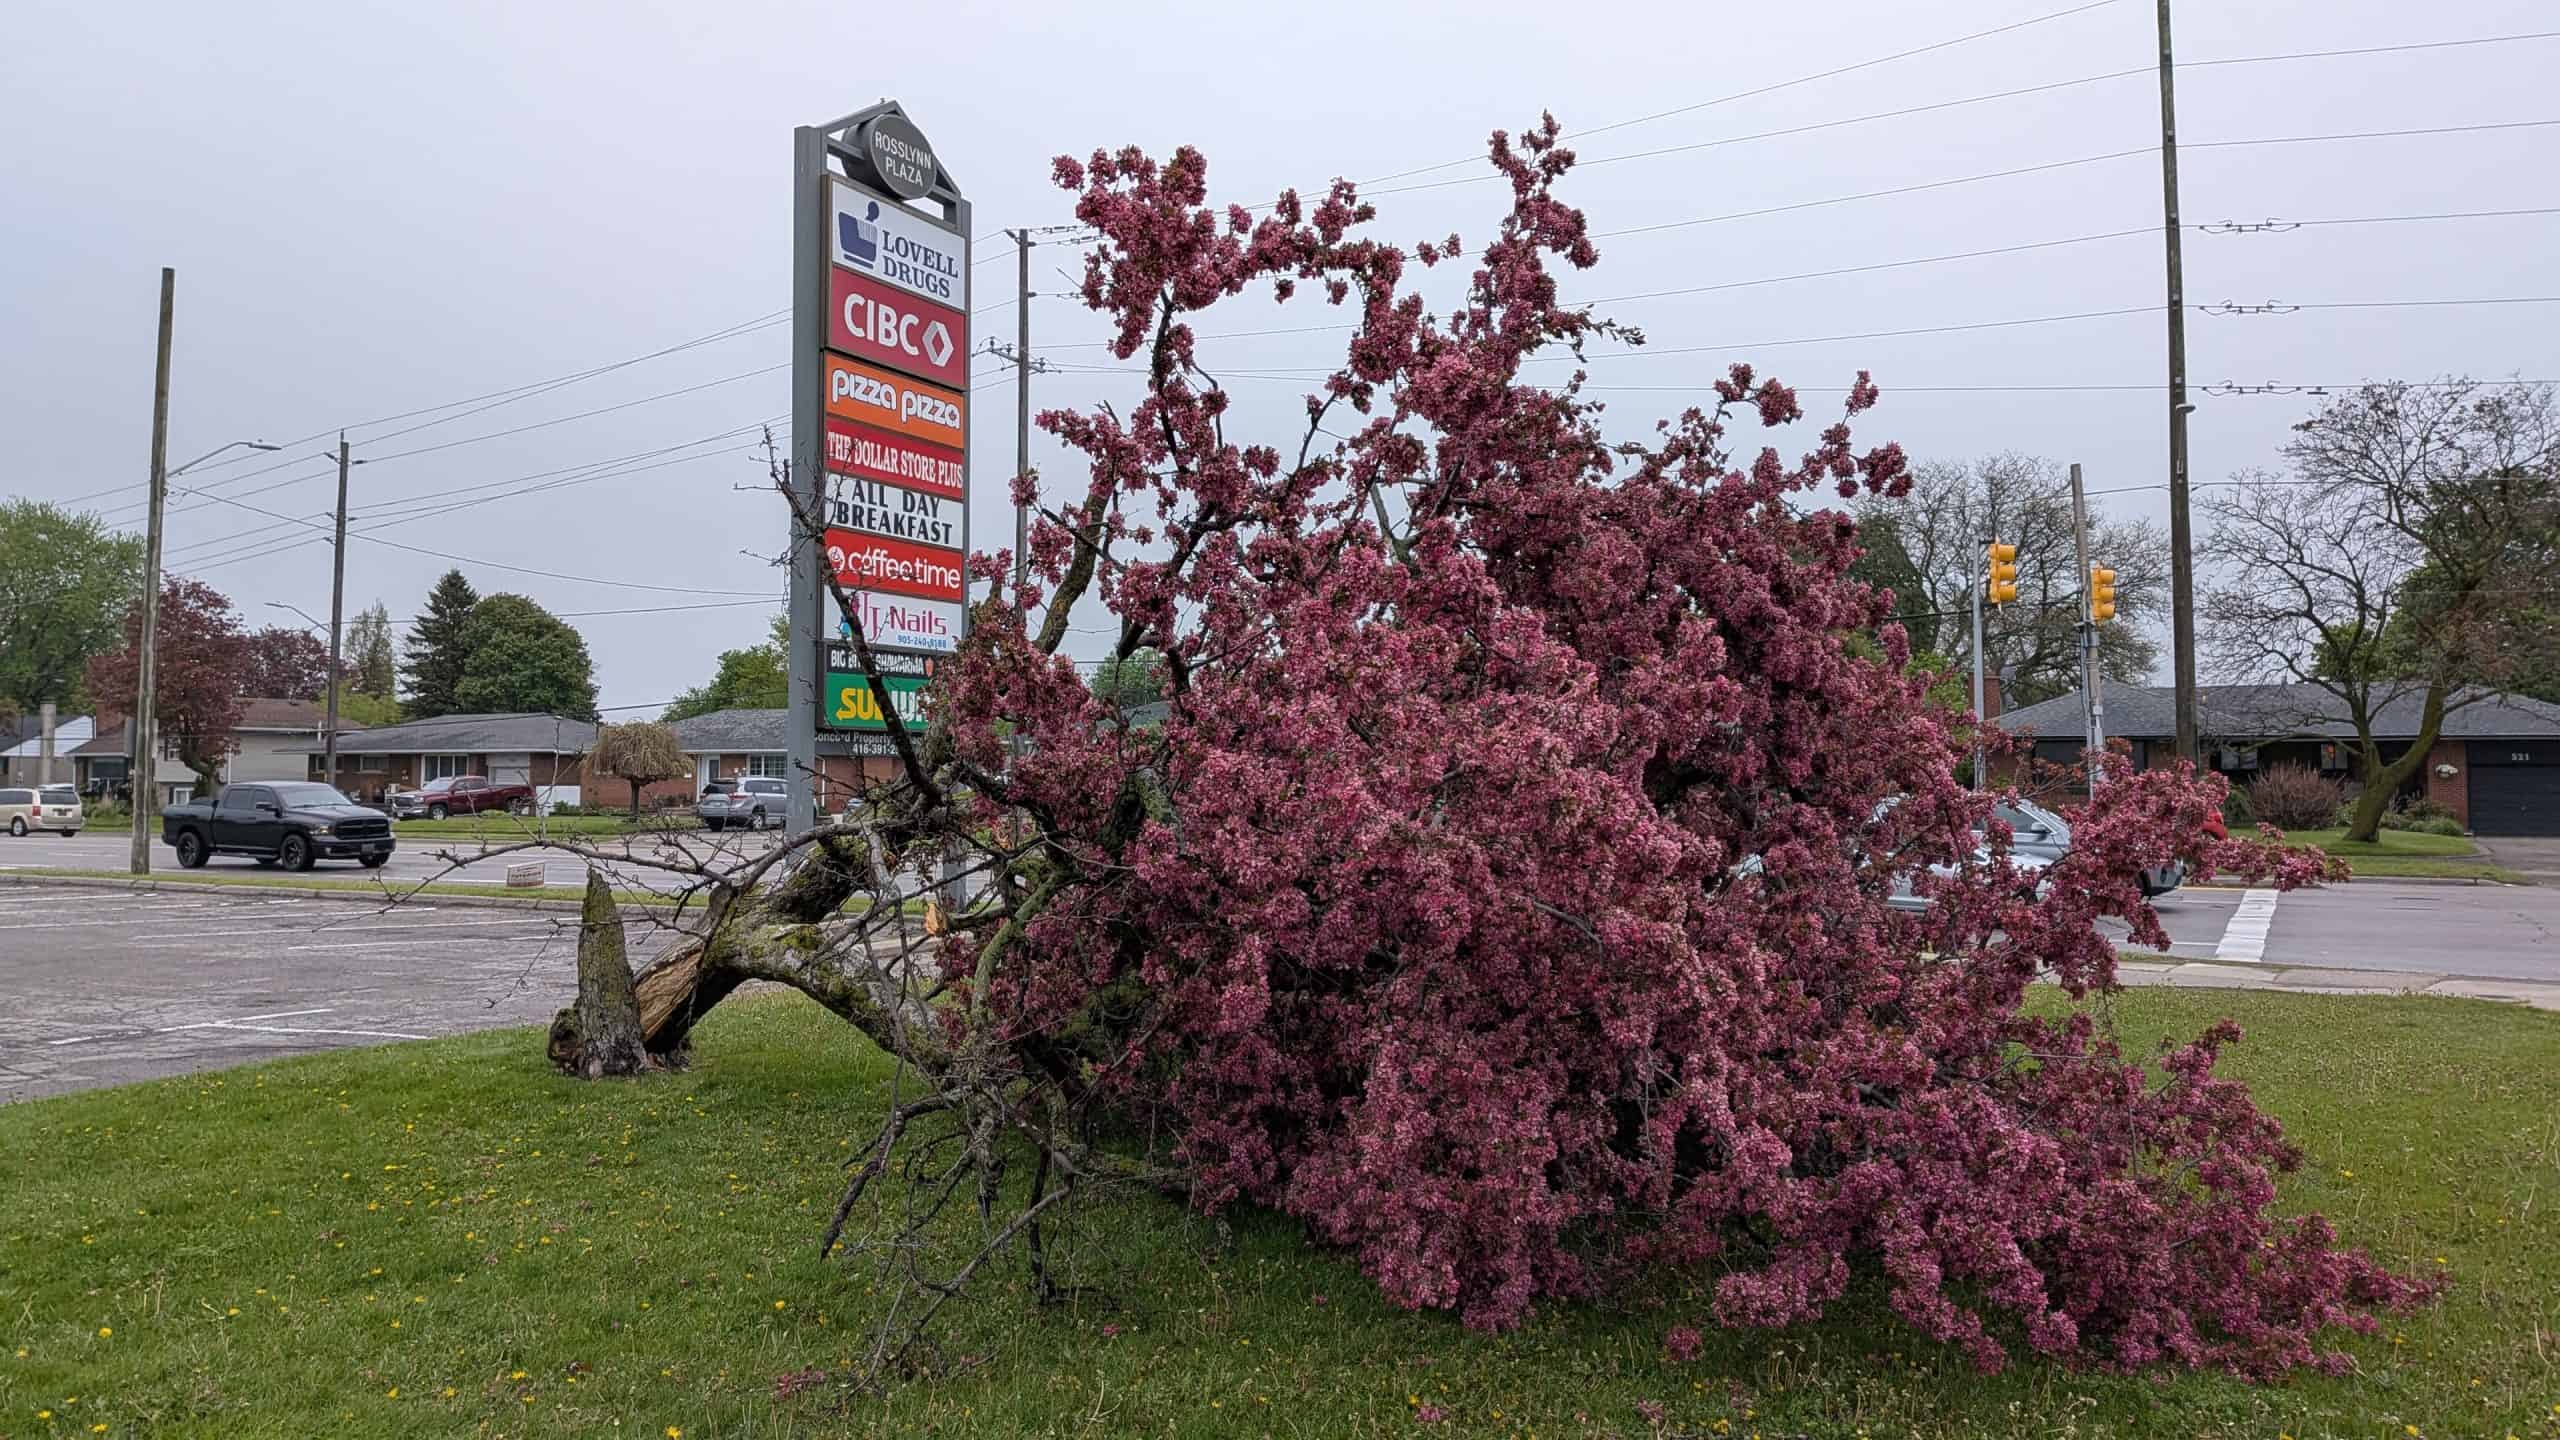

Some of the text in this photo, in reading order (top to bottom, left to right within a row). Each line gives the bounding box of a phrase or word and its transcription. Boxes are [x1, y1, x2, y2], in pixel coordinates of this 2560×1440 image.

[875, 131, 932, 169] ROSSLYNN
[885, 156, 923, 186] PLAZA
[882, 230, 958, 278] LOVELL
[883, 255, 950, 298] DRUGS
[844, 293, 920, 356] CIBC
[832, 369, 961, 429] pizza pizza
[827, 431, 963, 489] THE DOLLAR STORE PLUS
[852, 480, 940, 518] ALL DAY
[836, 501, 952, 545] BREAKFAST
[889, 606, 947, 635] Nails
[831, 649, 846, 668] BIG
[875, 653, 925, 675] SHAWARMA
[815, 732, 892, 746] oncord Property
[852, 743, 898, 755] 416-391-2
